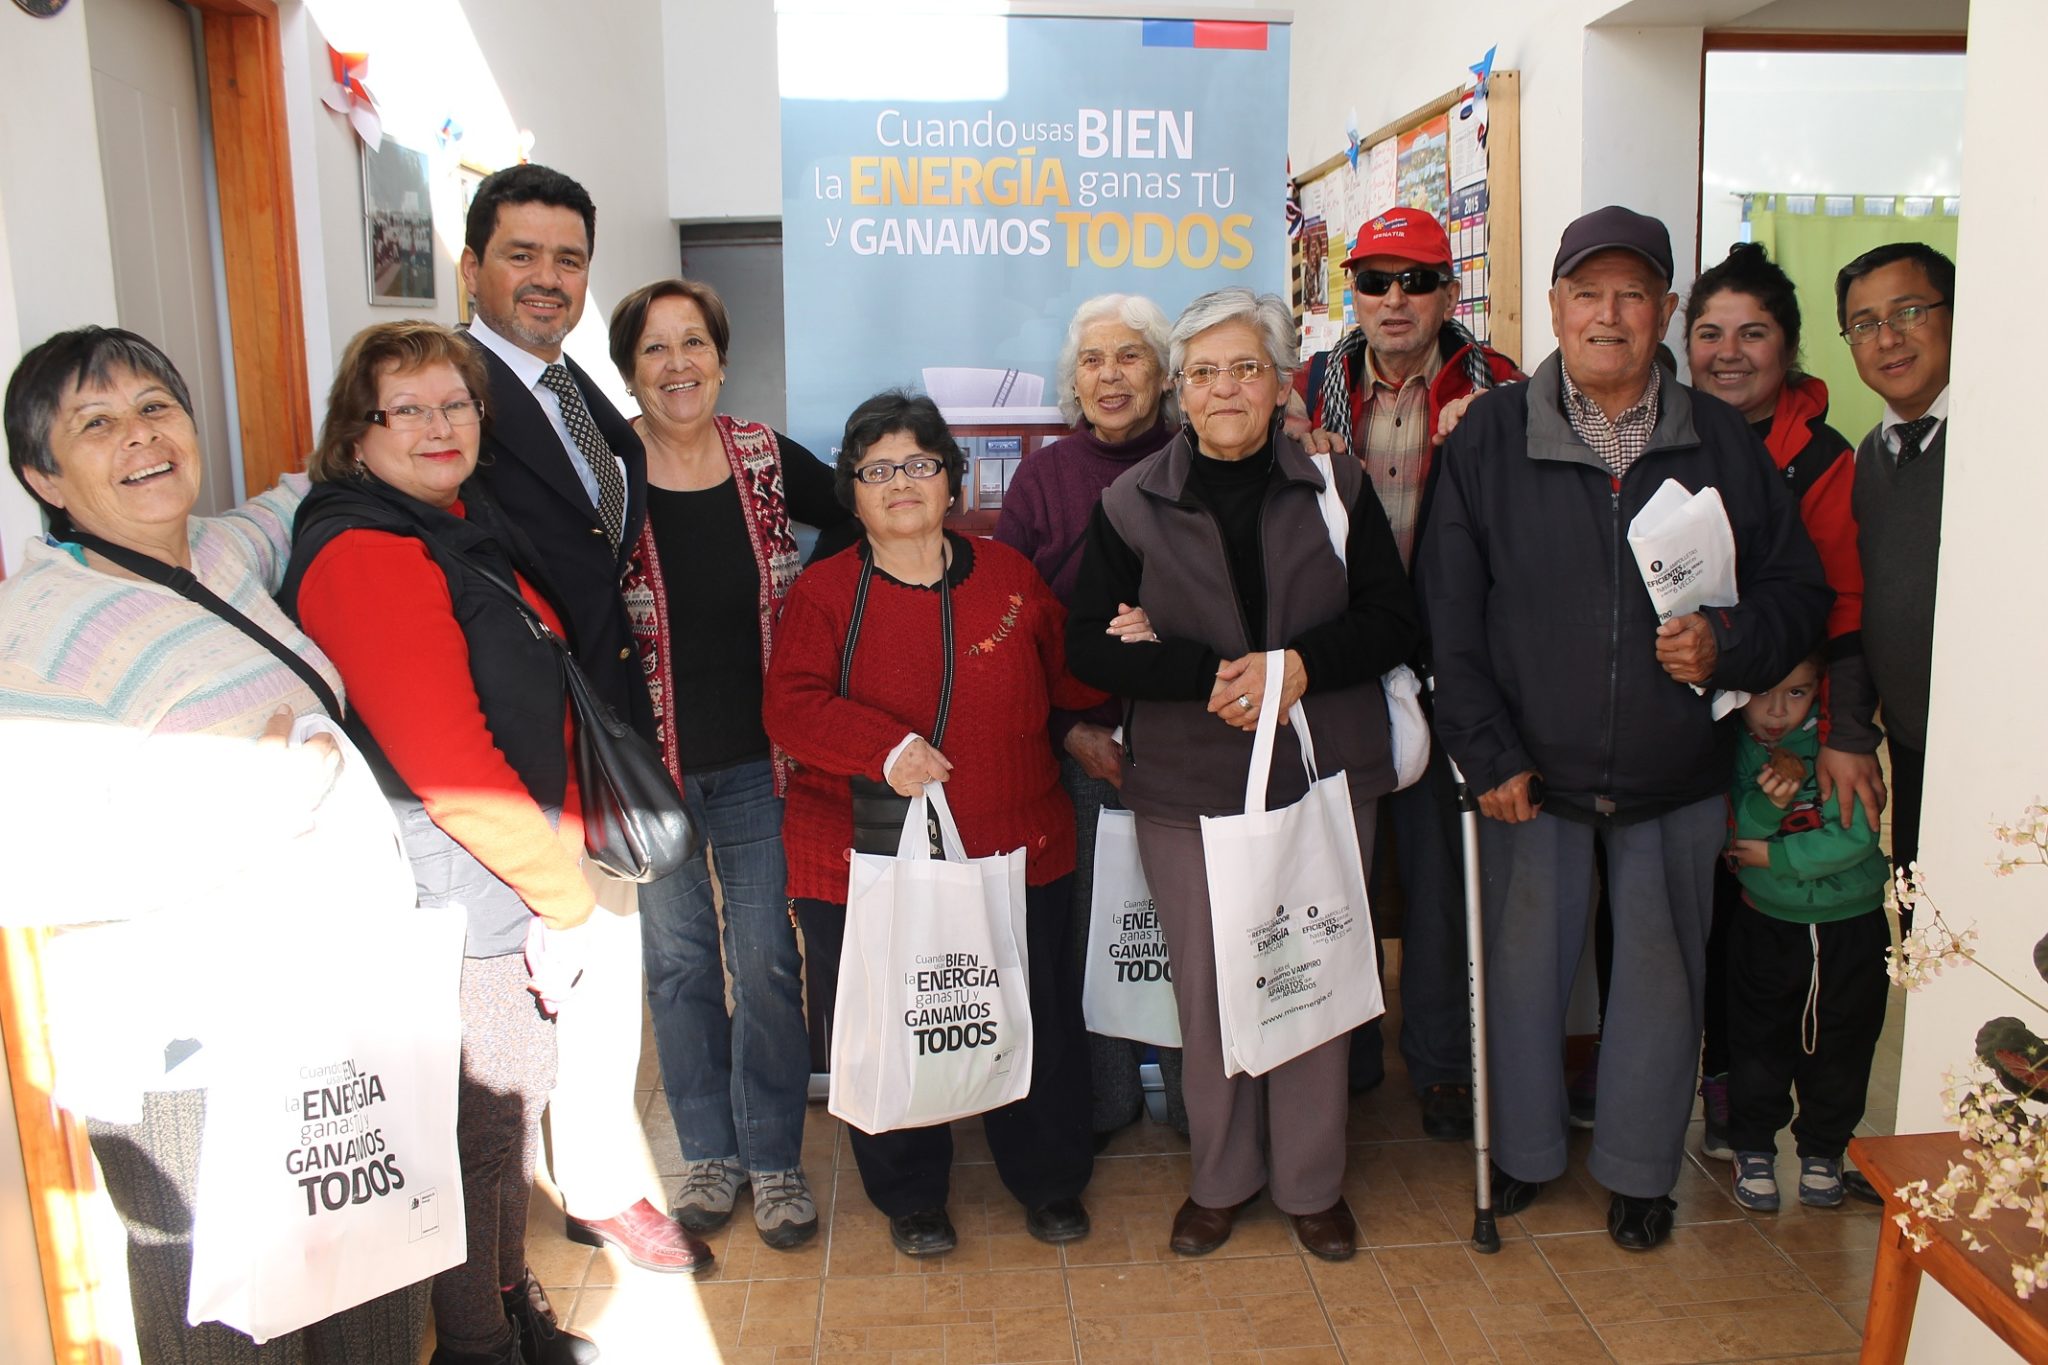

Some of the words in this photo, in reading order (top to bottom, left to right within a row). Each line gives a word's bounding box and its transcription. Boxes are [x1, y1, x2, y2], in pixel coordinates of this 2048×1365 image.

[876, 109, 1017, 148] Cuando
[1021, 118, 1074, 143] usas
[1077, 108, 1194, 161] BIEN
[815, 167, 843, 200] la
[849, 146, 1072, 207] ENERGÍA
[1078, 167, 1181, 208] ganas
[1191, 167, 1235, 209] TÚ
[1464, 195, 1479, 215] 2015
[824, 216, 843, 248] y
[849, 217, 1052, 256] GANAMOS
[1055, 212, 1254, 270] TODOS
[1647, 565, 1683, 587] EFICIENTES
[1678, 575, 1696, 589] VECES
[1124, 899, 1148, 908] Cuando
[1112, 913, 1121, 924] la
[1302, 917, 1336, 934] EFICIENTES
[1120, 930, 1152, 944] ganas
[1257, 927, 1289, 952] ENERGÍA
[915, 954, 945, 964] Cuando
[946, 953, 978, 967] BIEN
[1109, 943, 1167, 958] GANAM
[1291, 959, 1321, 975] VAMPIRO
[904, 972, 915, 985] la
[917, 965, 1000, 992] ENERGÍA
[1268, 979, 1303, 998] APARATOS
[915, 991, 952, 1009] ganas
[973, 990, 980, 1001] y
[1282, 982, 1316, 998] APAGADOS
[904, 1002, 991, 1027] GANAMOS
[913, 1020, 998, 1056] TODOS
[284, 1095, 300, 1113] la
[303, 1071, 386, 1121] ENERGÍA
[300, 1116, 354, 1146] ganas
[286, 1128, 385, 1175] GANAMOS
[298, 1153, 405, 1216] TODOS
